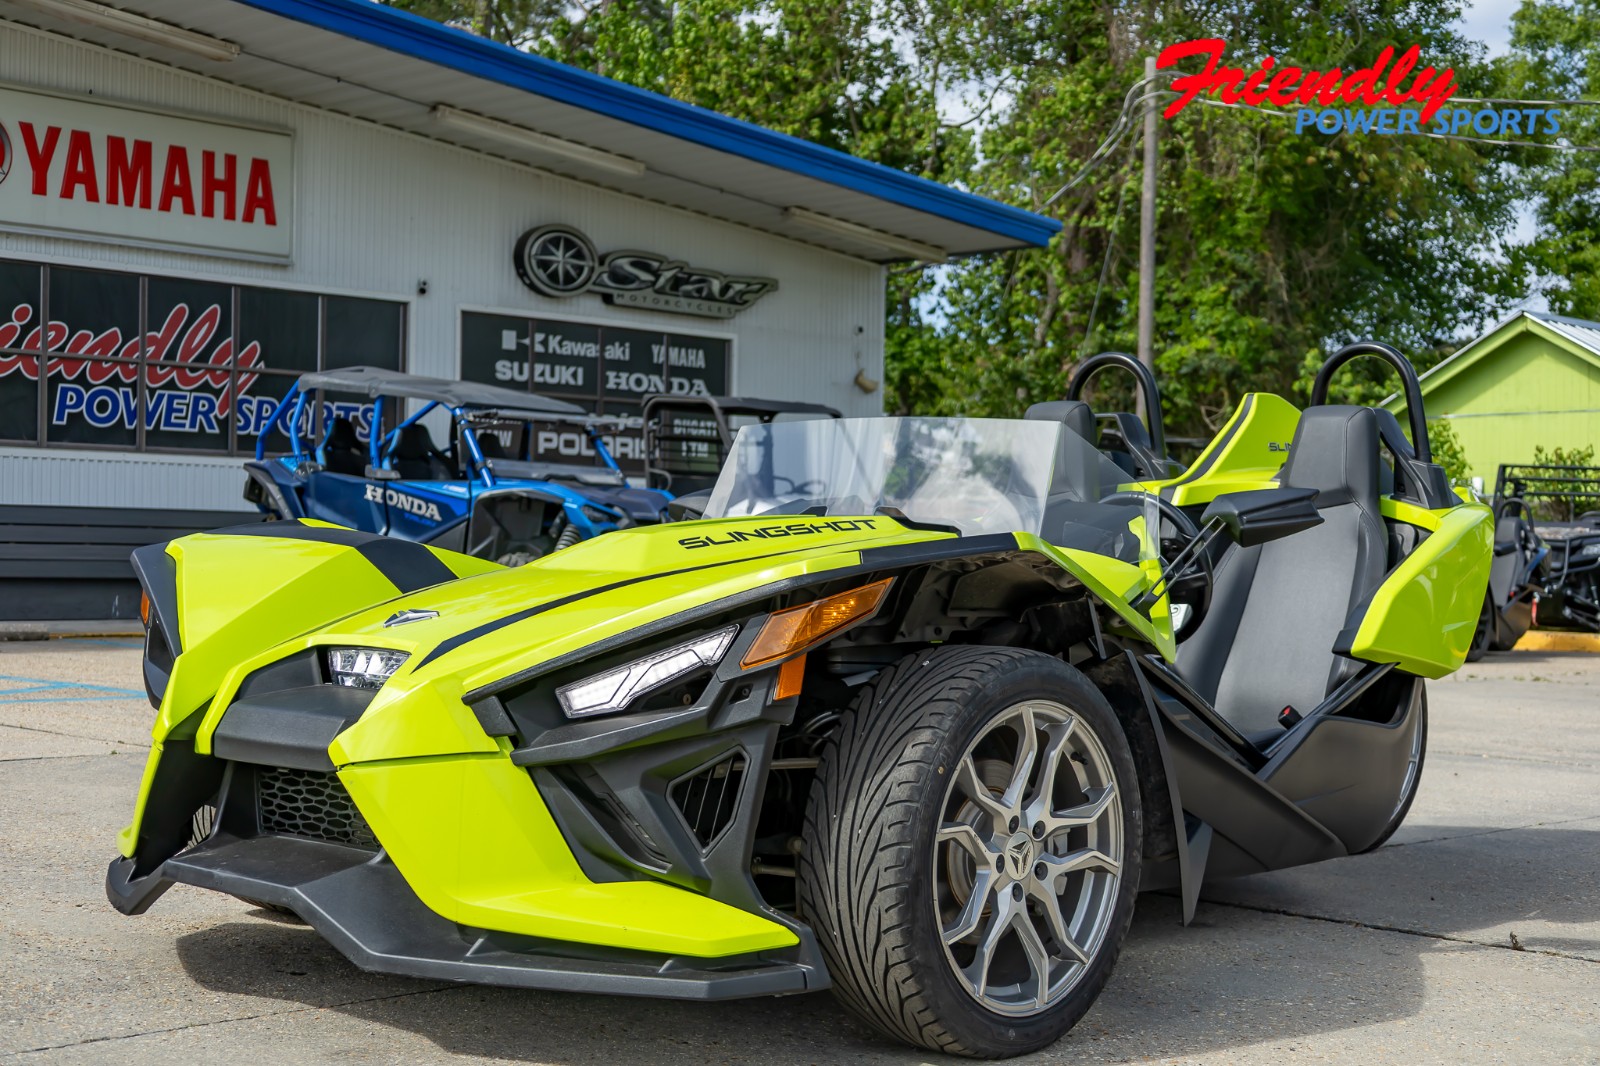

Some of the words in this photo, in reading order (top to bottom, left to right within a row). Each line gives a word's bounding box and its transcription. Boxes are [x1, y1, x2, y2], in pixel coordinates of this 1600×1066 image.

[18, 120, 277, 226] YAMAHA
[593, 255, 769, 305] Star
[615, 292, 734, 315] MOTORCYCLES
[652, 344, 706, 369] YAMAHA
[495, 360, 584, 386] SUZUKI
[606, 371, 711, 397] HONDA
[52, 383, 220, 434] POWER
[537, 431, 659, 460] POLARI
[364, 484, 442, 521] HONDA
[678, 519, 876, 550] SLINGSHOT
